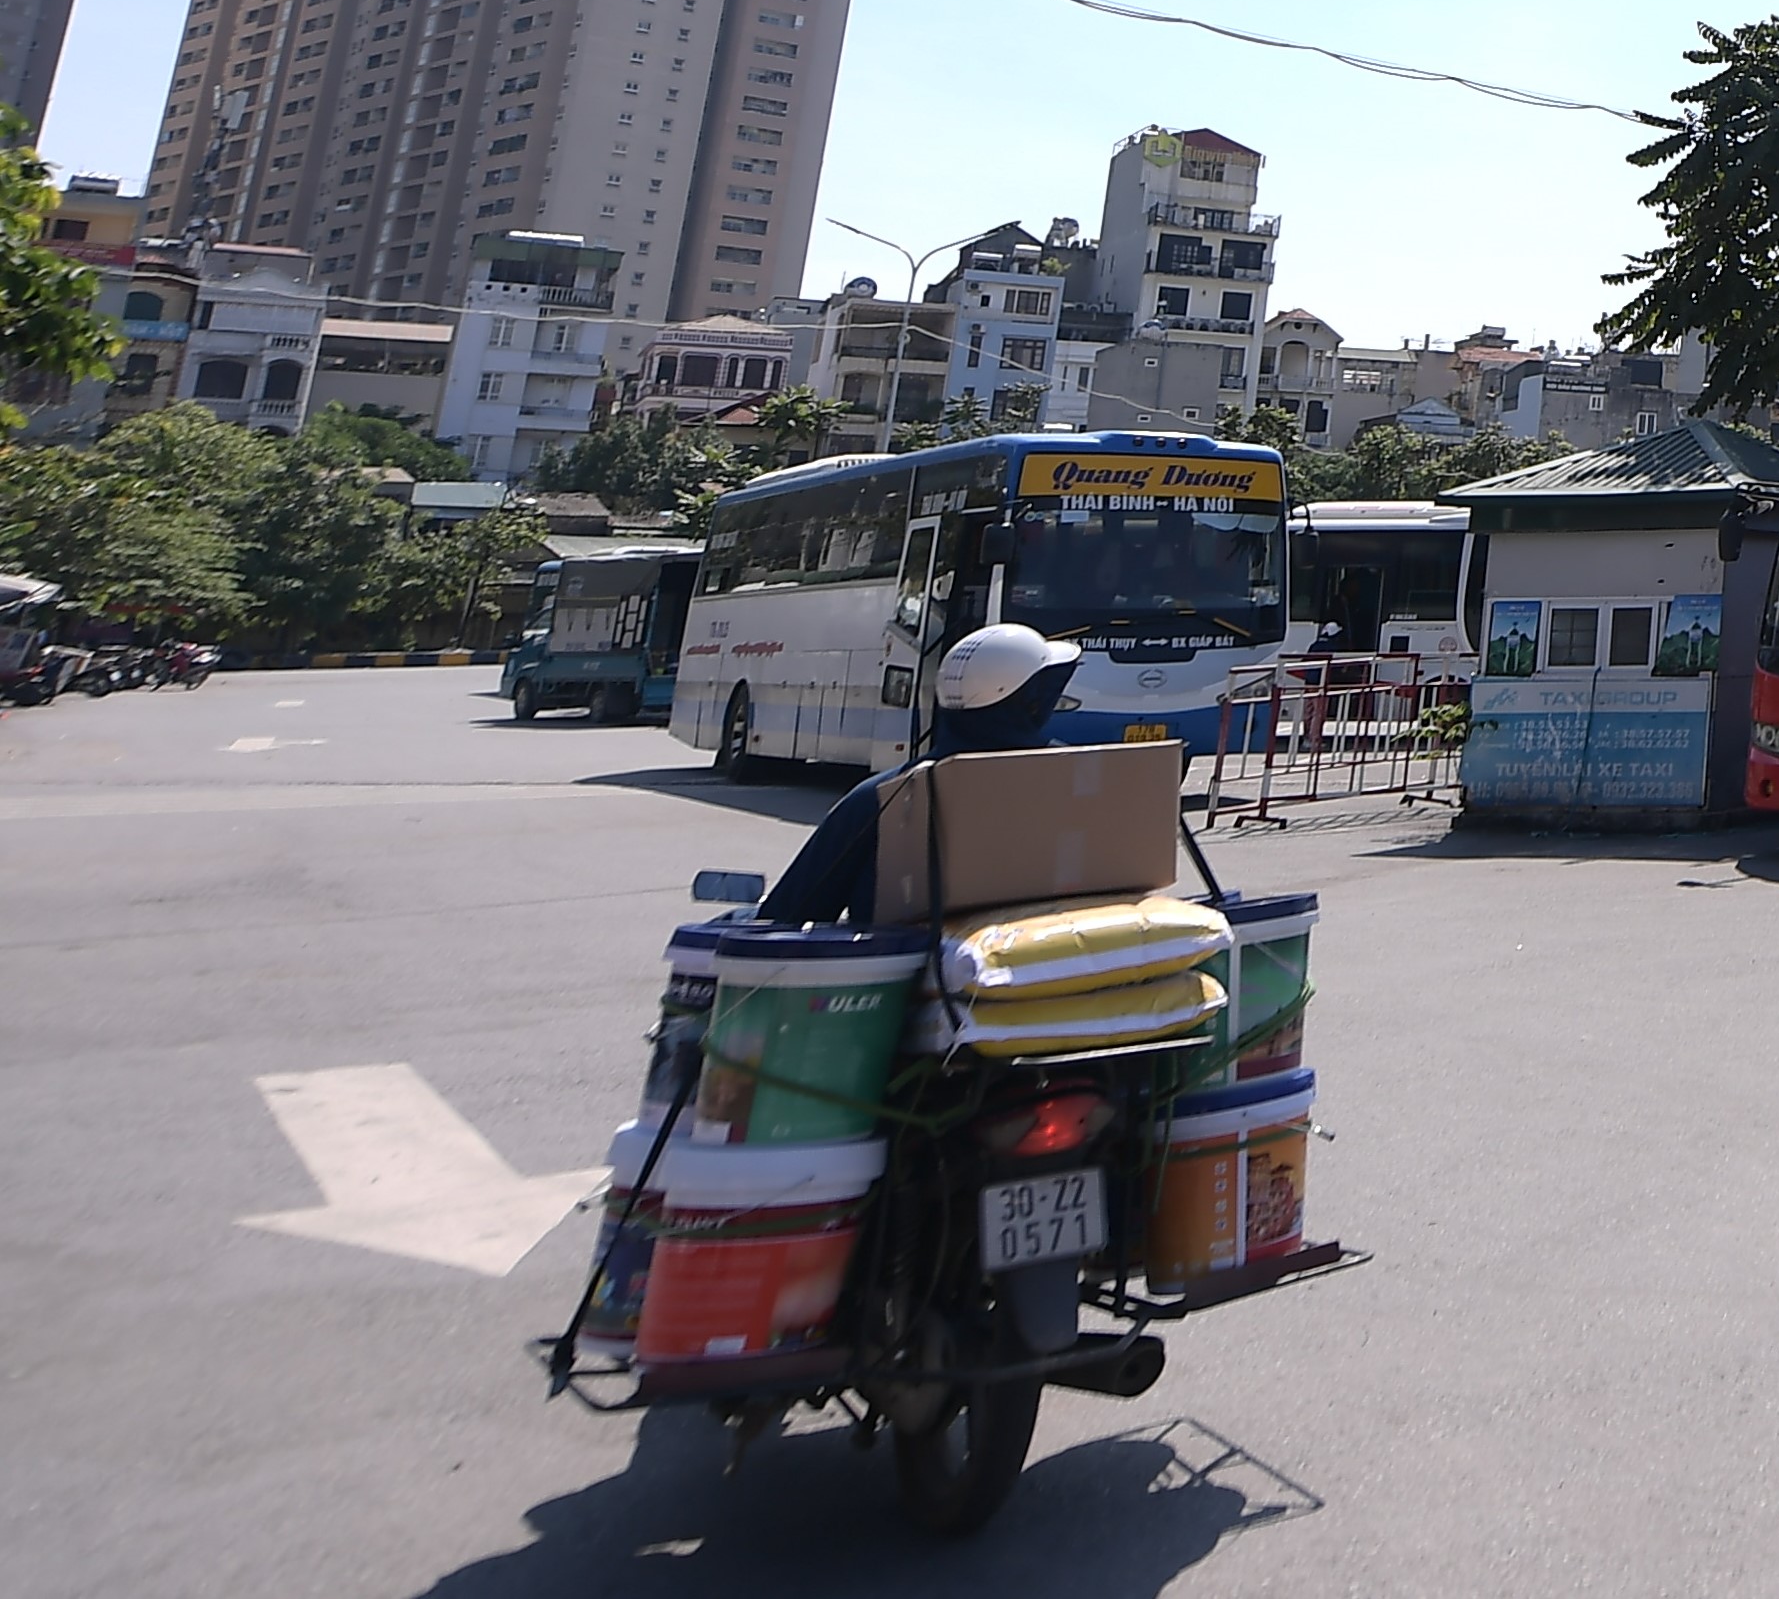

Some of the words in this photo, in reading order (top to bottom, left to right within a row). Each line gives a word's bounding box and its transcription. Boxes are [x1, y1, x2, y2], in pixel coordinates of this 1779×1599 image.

[1053, 462, 1153, 490] Quang
[1161, 465, 1256, 493] Dương
[1060, 492, 1103, 510] THÁI
[1109, 493, 1154, 511] BÌNH
[1174, 494, 1198, 511] HÀ
[1203, 495, 1234, 514] NỘI
[1082, 636, 1107, 648] THÁI
[1189, 635, 1214, 648] GIÁP
[1630, 763, 1674, 777] TAXI
[1000, 1176, 1086, 1221] 30-Z2
[1001, 1214, 1086, 1260] 0571
